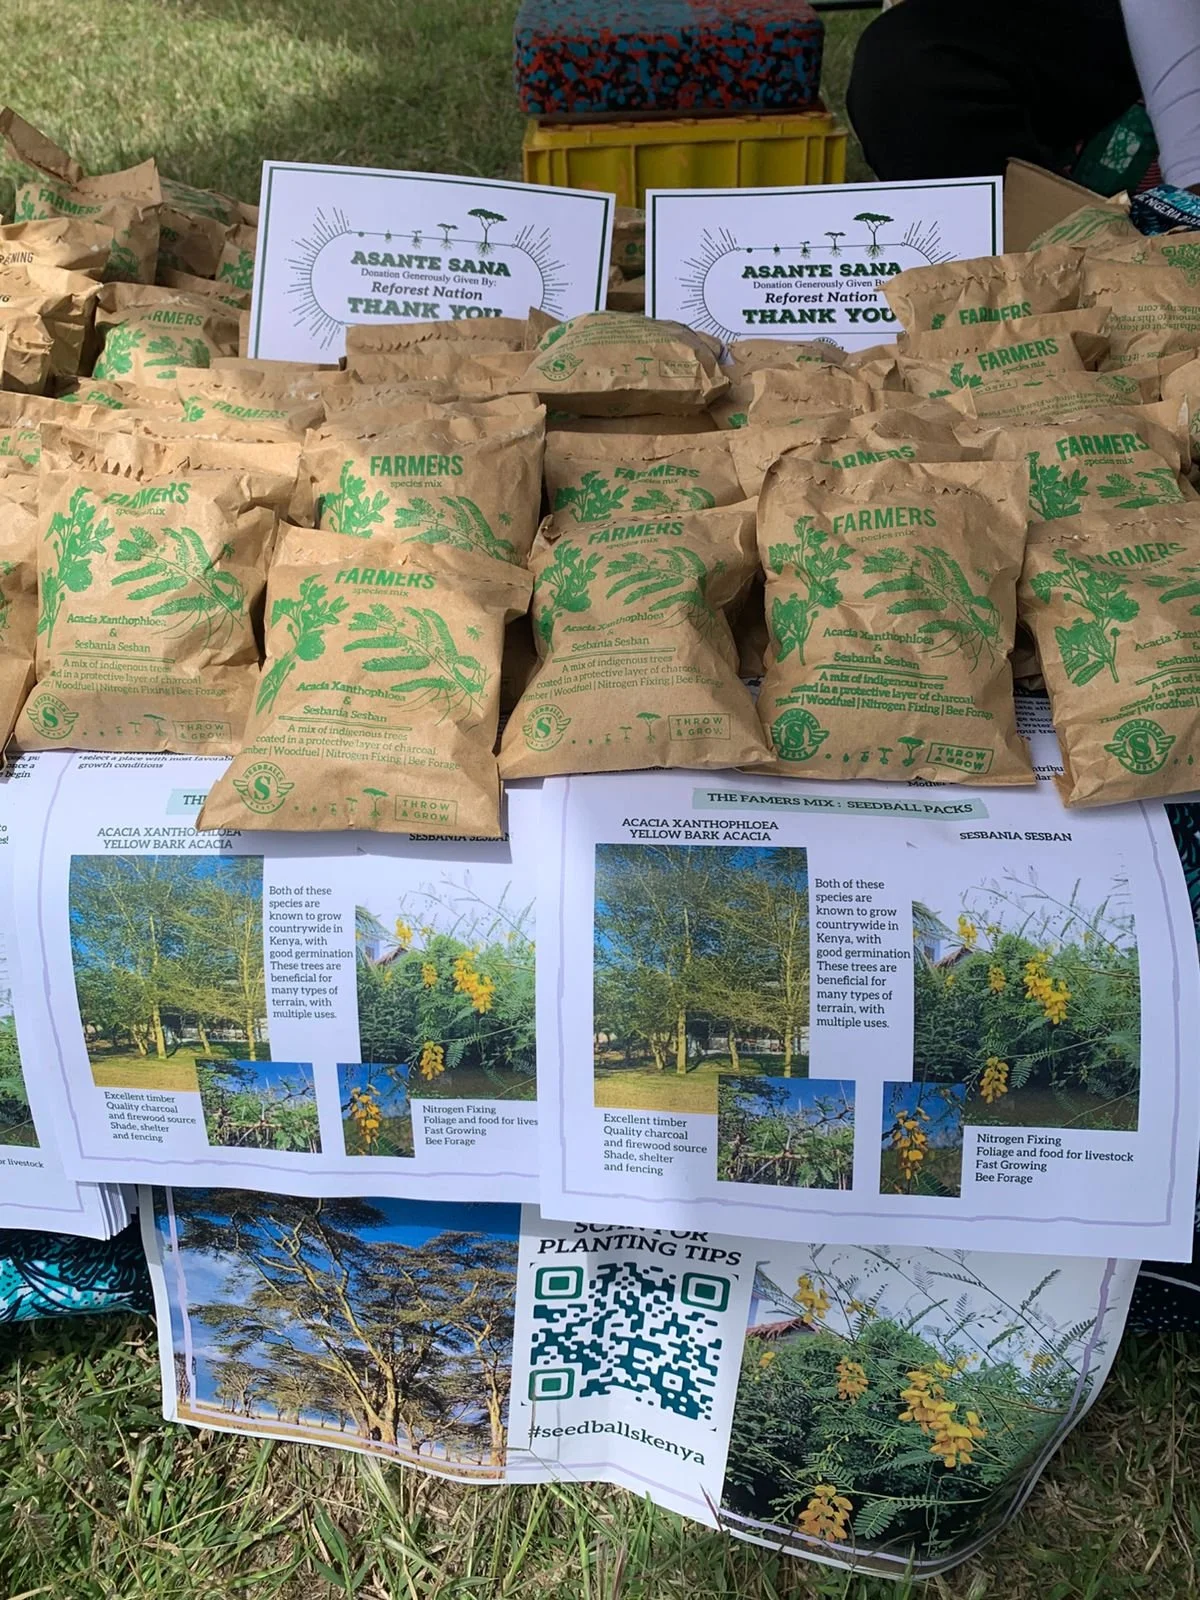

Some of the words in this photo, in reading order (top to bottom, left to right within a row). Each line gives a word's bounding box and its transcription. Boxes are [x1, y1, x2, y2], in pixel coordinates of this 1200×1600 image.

[351, 251, 441, 271] ASANTE
[448, 258, 511, 277] SANA
[741, 264, 833, 279] ASANTE
[840, 262, 902, 276] SANA
[361, 268, 400, 279] Donation
[402, 270, 451, 283] Generously
[453, 274, 478, 284] Given
[481, 276, 497, 287] By:
[371, 282, 429, 297] Reforest
[433, 287, 483, 300] Nation
[753, 280, 793, 289] Donation
[795, 280, 845, 290] Generously
[846, 279, 872, 288] Given
[765, 292, 824, 304] Reforest
[827, 291, 878, 302] Nation
[348, 298, 440, 318] THANK
[449, 304, 502, 320] YOU
[742, 308, 837, 324] THANK
[845, 308, 898, 323] YOU
[977, 338, 1060, 372] FARMERS
[212, 401, 288, 420] FARMERS
[1055, 433, 1150, 461] FARMERS
[370, 454, 464, 476] FARMERS
[614, 464, 700, 480] FARMERS
[390, 480, 423, 489] species
[424, 480, 442, 488] mix
[833, 506, 937, 534] FARMERS
[588, 522, 684, 545] FARMERS
[856, 531, 896, 542] species
[897, 528, 916, 538] mix
[334, 568, 437, 590] FARMERS
[296, 682, 329, 692] Acacia
[331, 681, 406, 702] Xanthophloea
[343, 696, 352, 706] &
[303, 706, 350, 718] Sesbania
[350, 710, 387, 722] Sesban
[288, 724, 296, 733] A
[297, 725, 316, 734] mix
[317, 726, 328, 735] of
[329, 726, 383, 740] indigenous
[384, 731, 408, 741] trees
[256, 735, 285, 744] coated
[287, 736, 297, 744] in
[299, 738, 305, 746] a
[305, 736, 354, 749] protective
[355, 740, 382, 752] layer
[383, 742, 393, 752] of
[274, 747, 320, 758] Woodfuel
[326, 749, 369, 761] Nitrogen
[371, 752, 402, 765] Fixing
[408, 757, 427, 766] Bee
[428, 759, 461, 770] Forage
[78, 762, 113, 770] growth
[402, 800, 451, 812] THROW
[707, 793, 738, 802] THE
[739, 794, 801, 806] FAMERS
[803, 798, 835, 808] MIX
[847, 800, 922, 813] SEEDBALL
[924, 804, 973, 814] PACKS
[414, 812, 450, 822] GROW
[622, 818, 670, 828] ACACIA
[672, 819, 779, 830] XANTHOPHLOEA
[97, 828, 141, 838] ACACIA
[629, 830, 682, 839] YELLOW
[684, 831, 720, 840] BARK
[722, 831, 772, 841] ACACIA
[960, 831, 1023, 841] SESBANIA
[1025, 832, 1072, 842] SESBAN
[103, 839, 150, 849] YELLOW
[153, 839, 186, 849] BARK
[188, 839, 233, 850] ACACIA
[815, 878, 841, 889] Both
[842, 878, 855, 889] of
[856, 879, 885, 890] these
[815, 892, 853, 904] species
[855, 894, 872, 903] are
[816, 905, 854, 916] known
[856, 907, 868, 916] to
[869, 908, 897, 918] grow
[816, 920, 886, 932] countrywide
[888, 921, 899, 931] in
[816, 933, 854, 946] Kenya,
[856, 934, 882, 944] with
[816, 947, 843, 958] good
[844, 948, 911, 960] germination
[816, 961, 849, 972] These
[851, 962, 878, 972] trees
[879, 964, 897, 972] are
[816, 974, 869, 986] beneficial
[870, 976, 886, 986] for
[816, 990, 848, 1001] many
[850, 990, 880, 1002] types
[881, 990, 893, 1000] of
[816, 1004, 857, 1015] terrain,
[858, 1004, 885, 1014] with
[816, 1016, 862, 1028] multiple
[863, 1020, 890, 1028] uses.
[104, 1092, 145, 1102] Excellent
[146, 1094, 176, 1103] timber
[106, 1102, 139, 1112] Quality
[141, 1104, 179, 1114] charcoal
[108, 1112, 125, 1120] and
[127, 1112, 166, 1122] firewood
[604, 1113, 651, 1125] Excellent
[652, 1116, 687, 1128] timber
[110, 1122, 139, 1131] Shade,
[140, 1124, 170, 1132] shelter
[424, 1126, 444, 1135] Fast
[445, 1126, 487, 1136] Growing
[603, 1126, 642, 1138] Quality
[644, 1128, 688, 1140] charcoal
[112, 1132, 130, 1140] and
[130, 1132, 164, 1143] fencing
[425, 1137, 442, 1145] Bee
[444, 1138, 476, 1146] Forage
[977, 1134, 1025, 1146] Nitrogen
[1026, 1134, 1062, 1147] Fixing
[604, 1139, 623, 1148] and
[625, 1139, 671, 1151] firewood
[673, 1145, 708, 1154] source
[604, 1150, 637, 1162] Shade,
[639, 1152, 675, 1164] shelter
[976, 1147, 1014, 1158] Foliage
[1016, 1148, 1037, 1158] and
[1039, 1148, 1064, 1158] food
[1066, 1150, 1083, 1160] for
[1085, 1150, 1134, 1162] livestock
[7, 1158, 44, 1168] livestock
[604, 1163, 624, 1172] and
[625, 1164, 664, 1176] fencing
[976, 1160, 998, 1170] Fast
[1000, 1160, 1047, 1172] Growing
[975, 1172, 995, 1182] Bee
[996, 1173, 1033, 1184] Forage
[538, 1234, 678, 1256] PLANTING
[685, 1245, 742, 1266] TIPS
[528, 1420, 705, 1466] #seedballskenya
